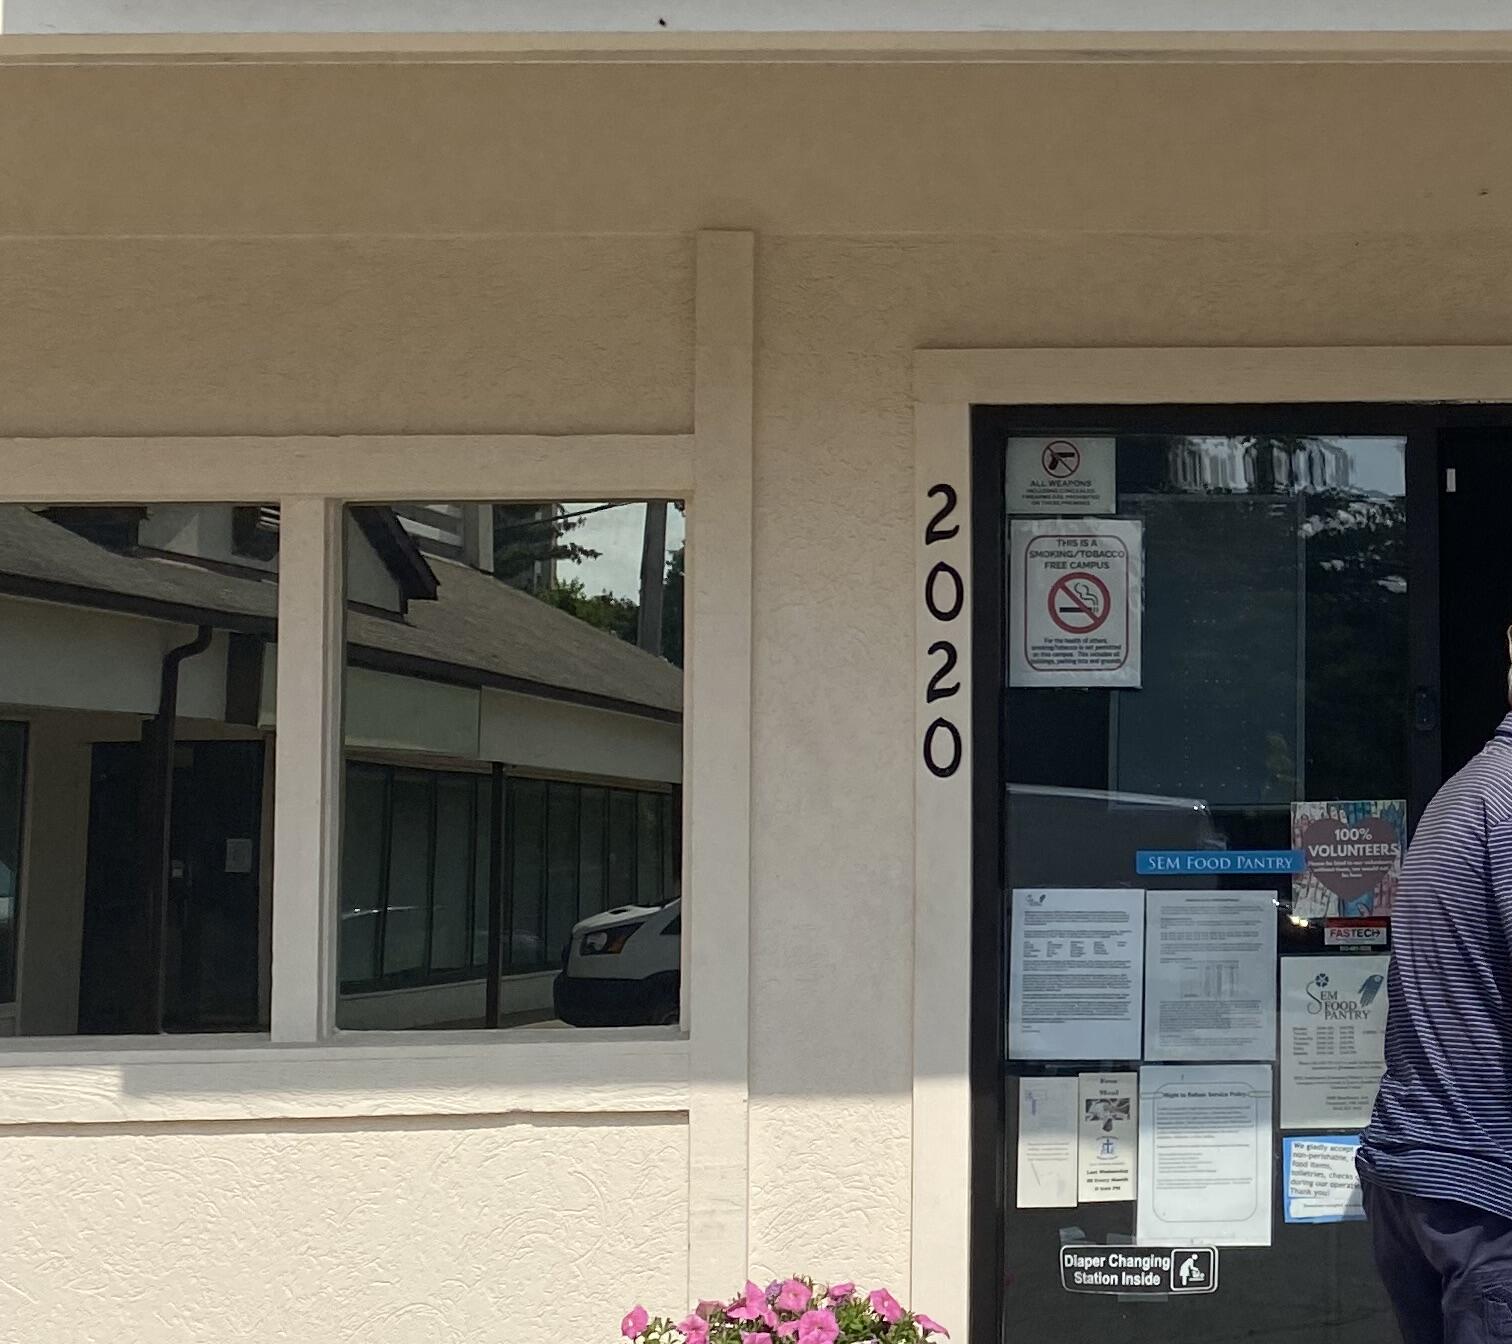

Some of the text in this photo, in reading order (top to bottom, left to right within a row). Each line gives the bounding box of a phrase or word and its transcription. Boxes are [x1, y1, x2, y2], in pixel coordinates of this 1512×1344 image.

[1057, 539, 1098, 547] THIS IS A
[1029, 550, 1125, 558] SMOKING/TOBACCO
[1044, 561, 1110, 569] FREE CAMPUS
[924, 484, 963, 778] 2020
[1334, 828, 1373, 841] 100%
[1308, 843, 1398, 857] VOLUNTEERS
[1148, 855, 1293, 869] SEM FOOD PANTRY
[1306, 980, 1338, 1015] SEM
[1324, 1000, 1358, 1011] FOOD
[1324, 1010, 1370, 1021] PANTRY
[1064, 1254, 1171, 1271] Diaper Changing
[1073, 1271, 1161, 1286] Station Inside
